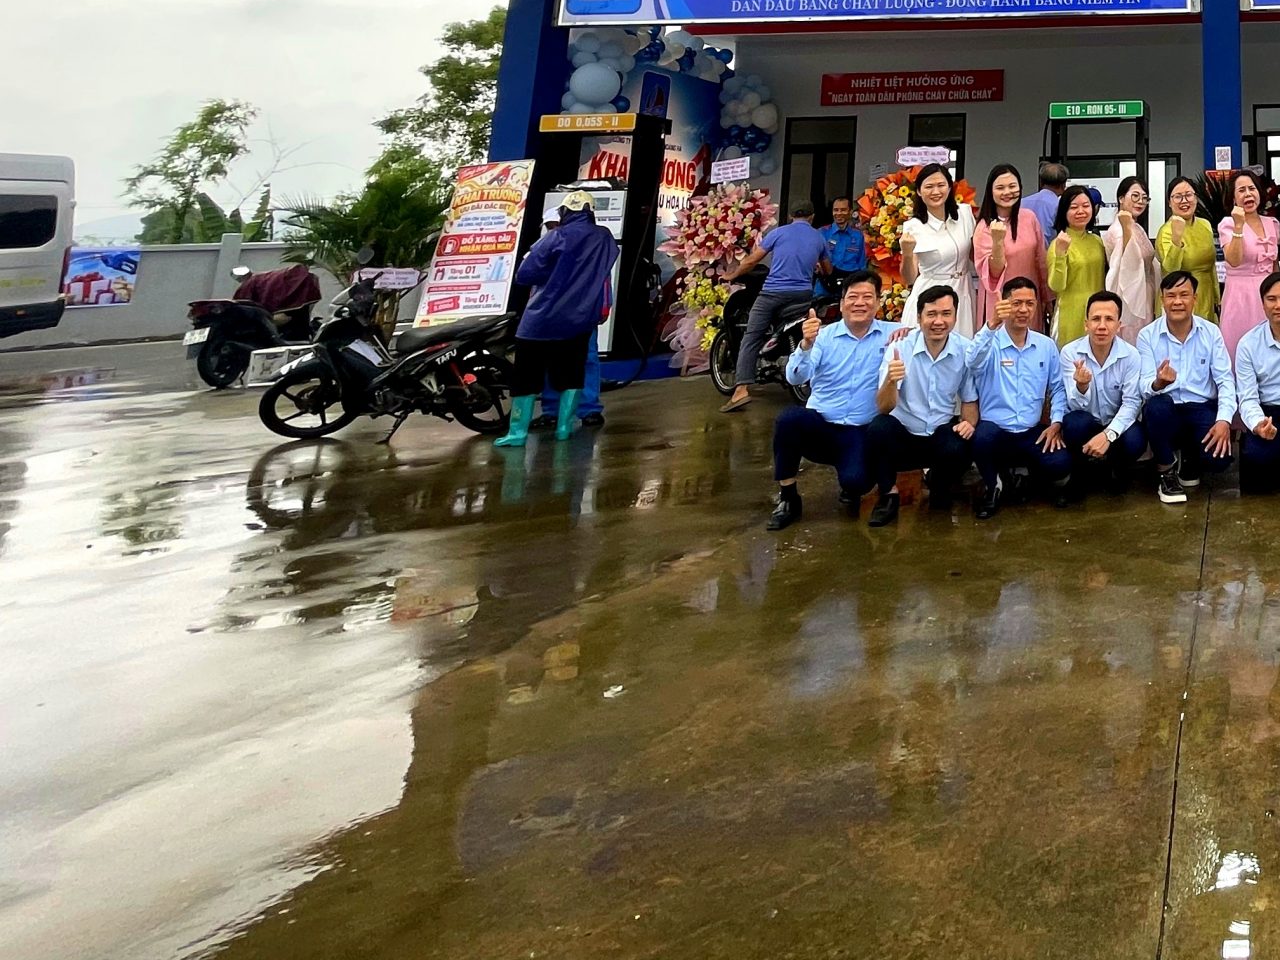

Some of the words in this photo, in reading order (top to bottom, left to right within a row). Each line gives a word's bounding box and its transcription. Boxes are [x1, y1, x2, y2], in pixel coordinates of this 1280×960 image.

[851, 76, 881, 90] NHIỆT
[884, 75, 903, 90] LIỆT
[906, 73, 947, 86] HƯỞNG
[950, 73, 974, 85] ỨNG
[1066, 105, 1080, 115] E10
[1087, 104, 1103, 115] RON
[557, 118, 570, 127] DO
[588, 149, 628, 181] KHA
[454, 190, 481, 206] KHAI
[465, 266, 476, 274] 01
[479, 294, 489, 302] 01
